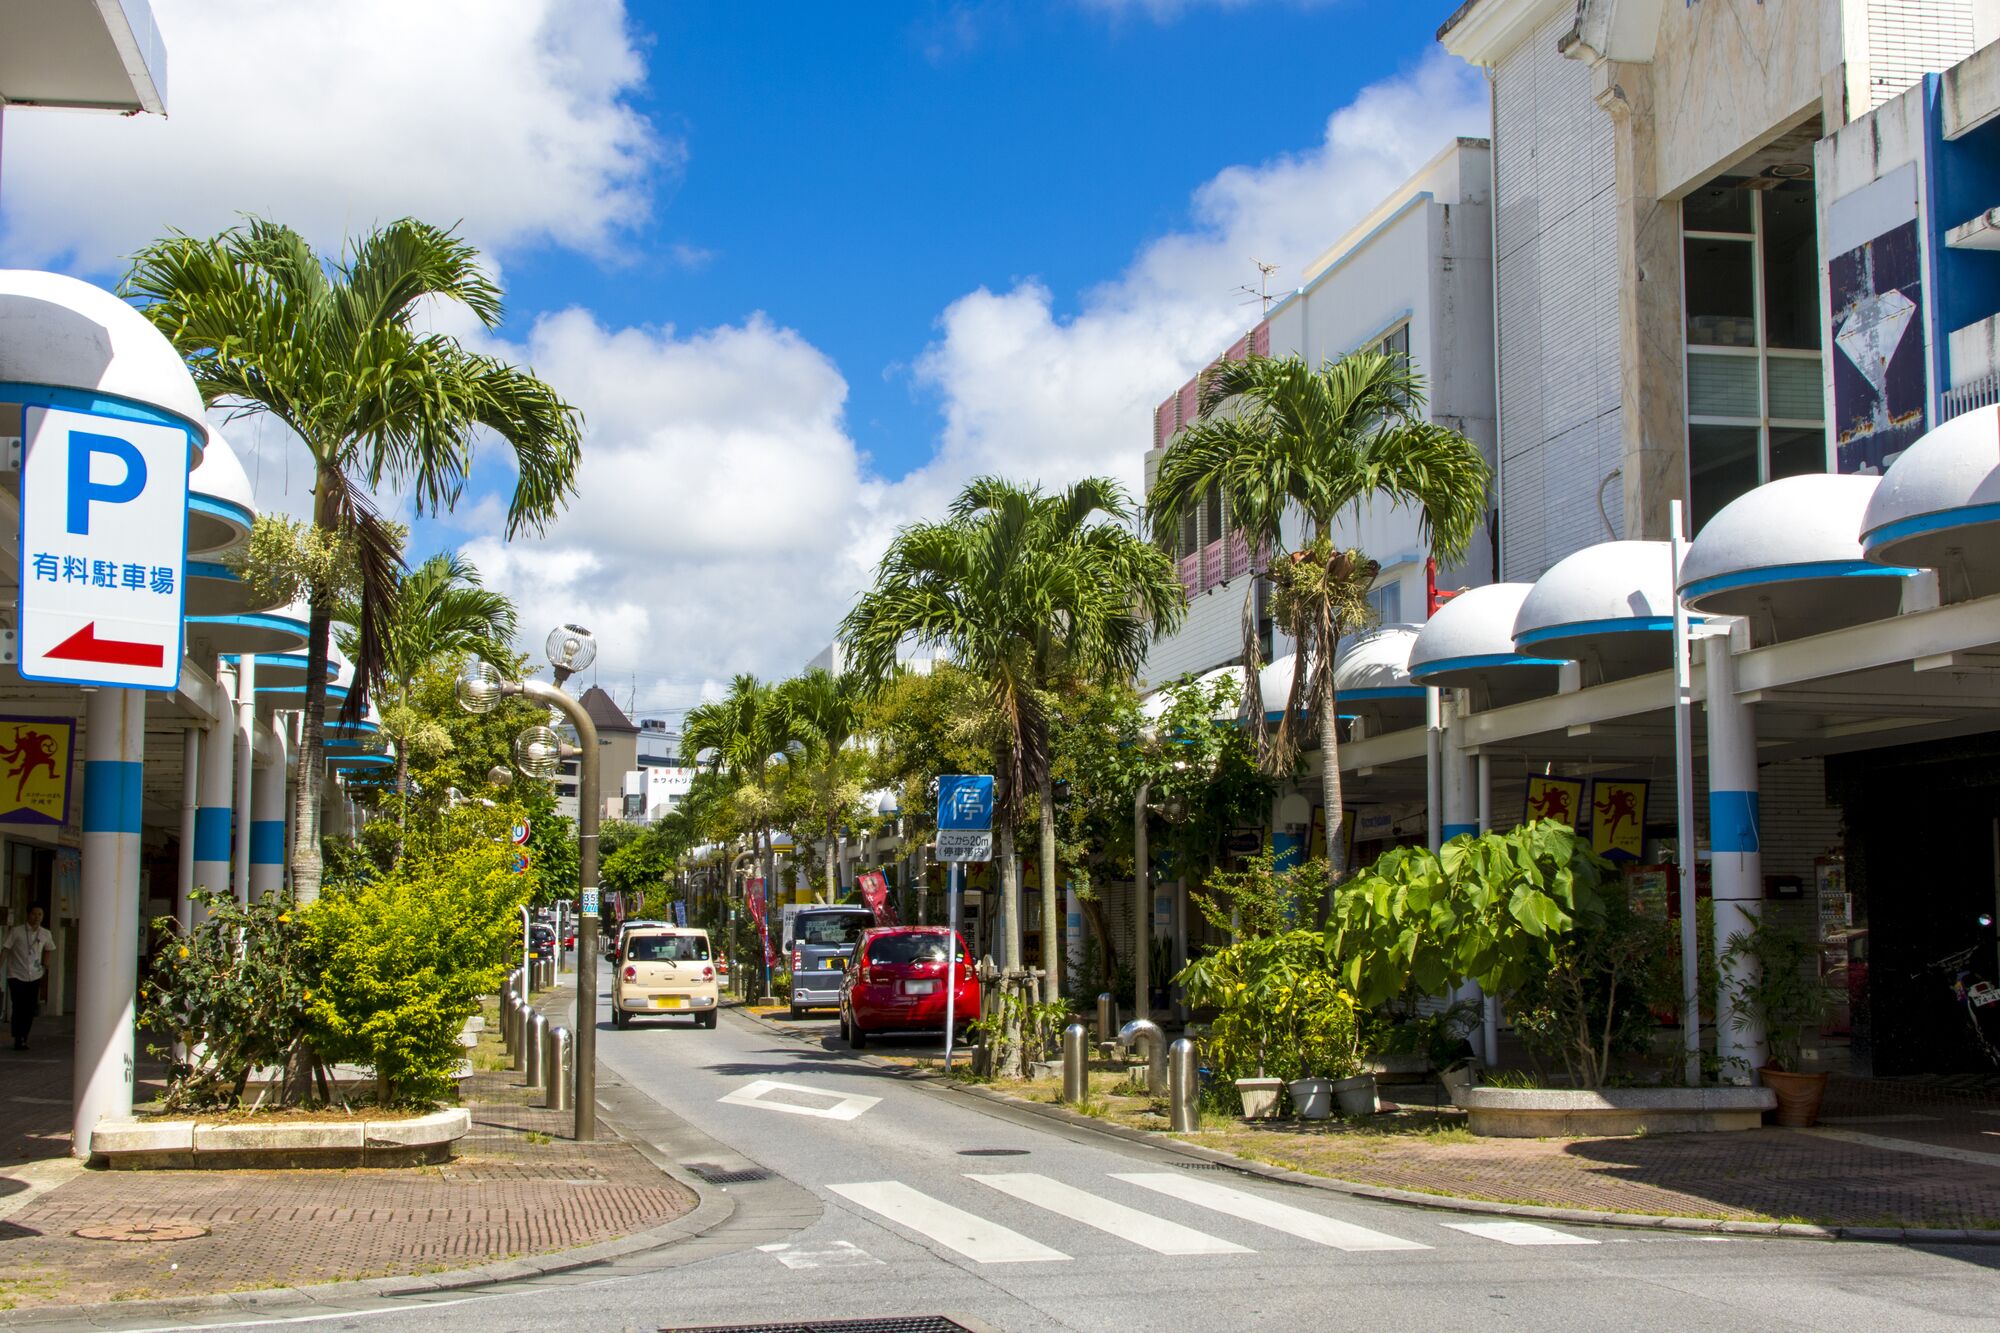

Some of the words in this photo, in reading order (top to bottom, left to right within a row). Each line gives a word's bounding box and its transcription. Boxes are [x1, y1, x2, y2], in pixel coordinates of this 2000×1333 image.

[66, 429, 148, 536] P
[32, 552, 175, 595] 有料駐車場
[947, 785, 984, 821] 停
[940, 835, 989, 847] ここから20m
